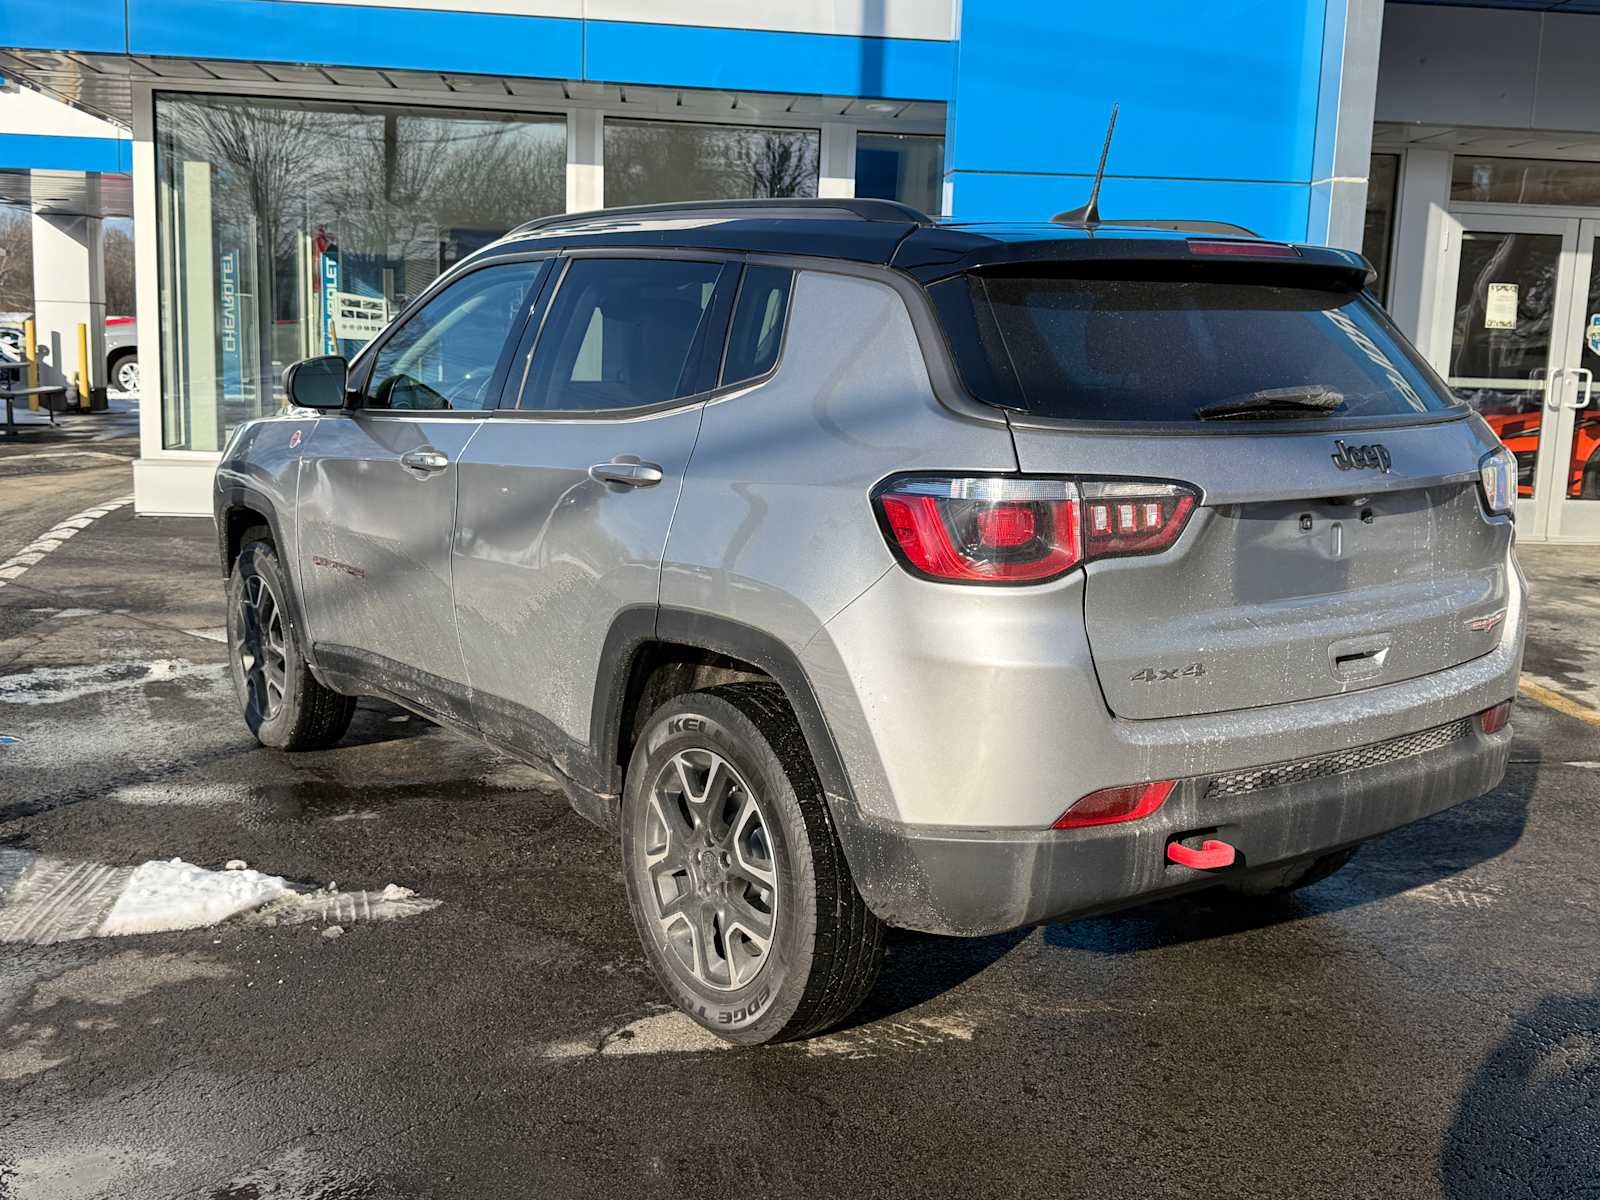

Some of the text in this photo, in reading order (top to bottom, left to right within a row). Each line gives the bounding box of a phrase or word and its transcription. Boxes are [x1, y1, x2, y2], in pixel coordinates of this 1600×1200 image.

[325, 257, 338, 355] CHVROLET
[1331, 439, 1391, 474] Jeep
[1128, 662, 1206, 683] 4x4
[719, 985, 771, 1025] EDGE
